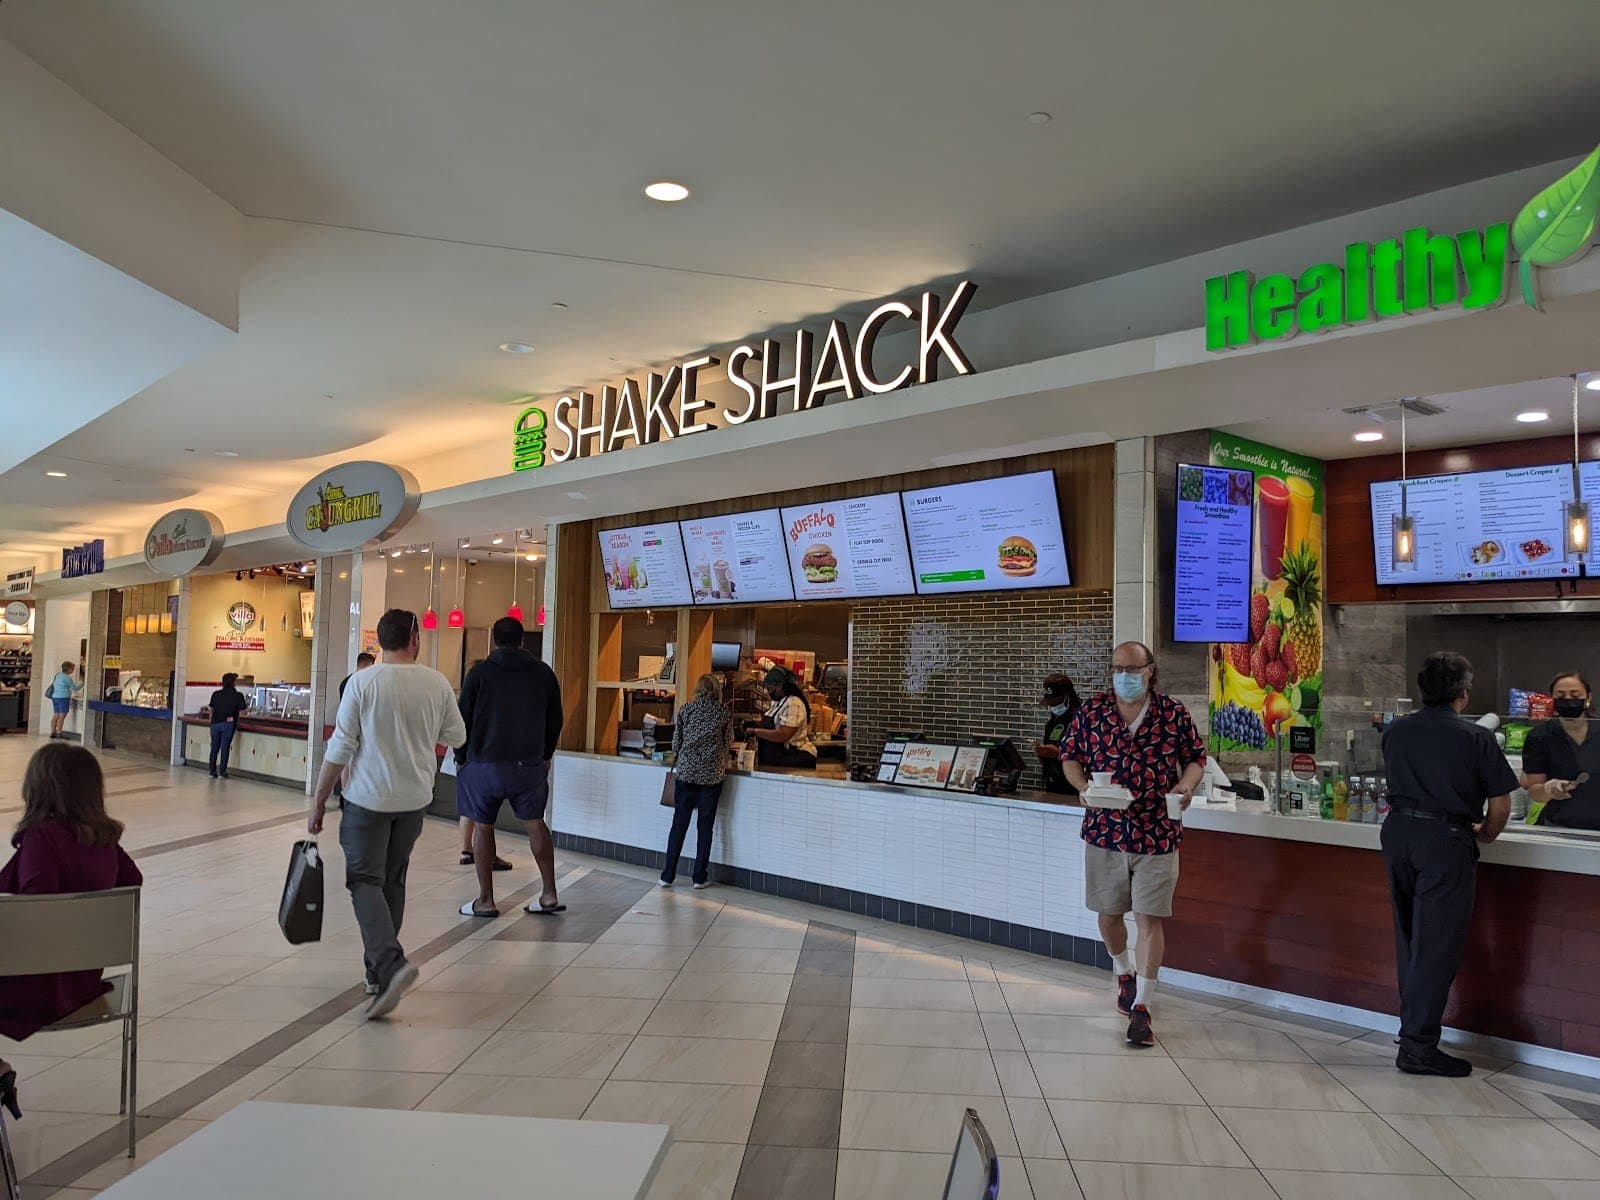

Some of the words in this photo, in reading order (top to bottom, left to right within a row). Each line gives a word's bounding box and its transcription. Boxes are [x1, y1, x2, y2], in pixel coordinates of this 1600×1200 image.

[1205, 222, 1509, 351] Healthy
[550, 357, 717, 463] SHAKE
[723, 281, 972, 425] SHACK
[1213, 442, 1229, 457] Our
[1233, 447, 1268, 468] Smoothie
[1270, 460, 1278, 470] is
[344, 491, 381, 523] GRILL
[917, 496, 942, 504] BURGERS
[789, 508, 835, 543] BUFFALO
[808, 531, 832, 540] CHICKEN
[229, 611, 253, 620] villa
